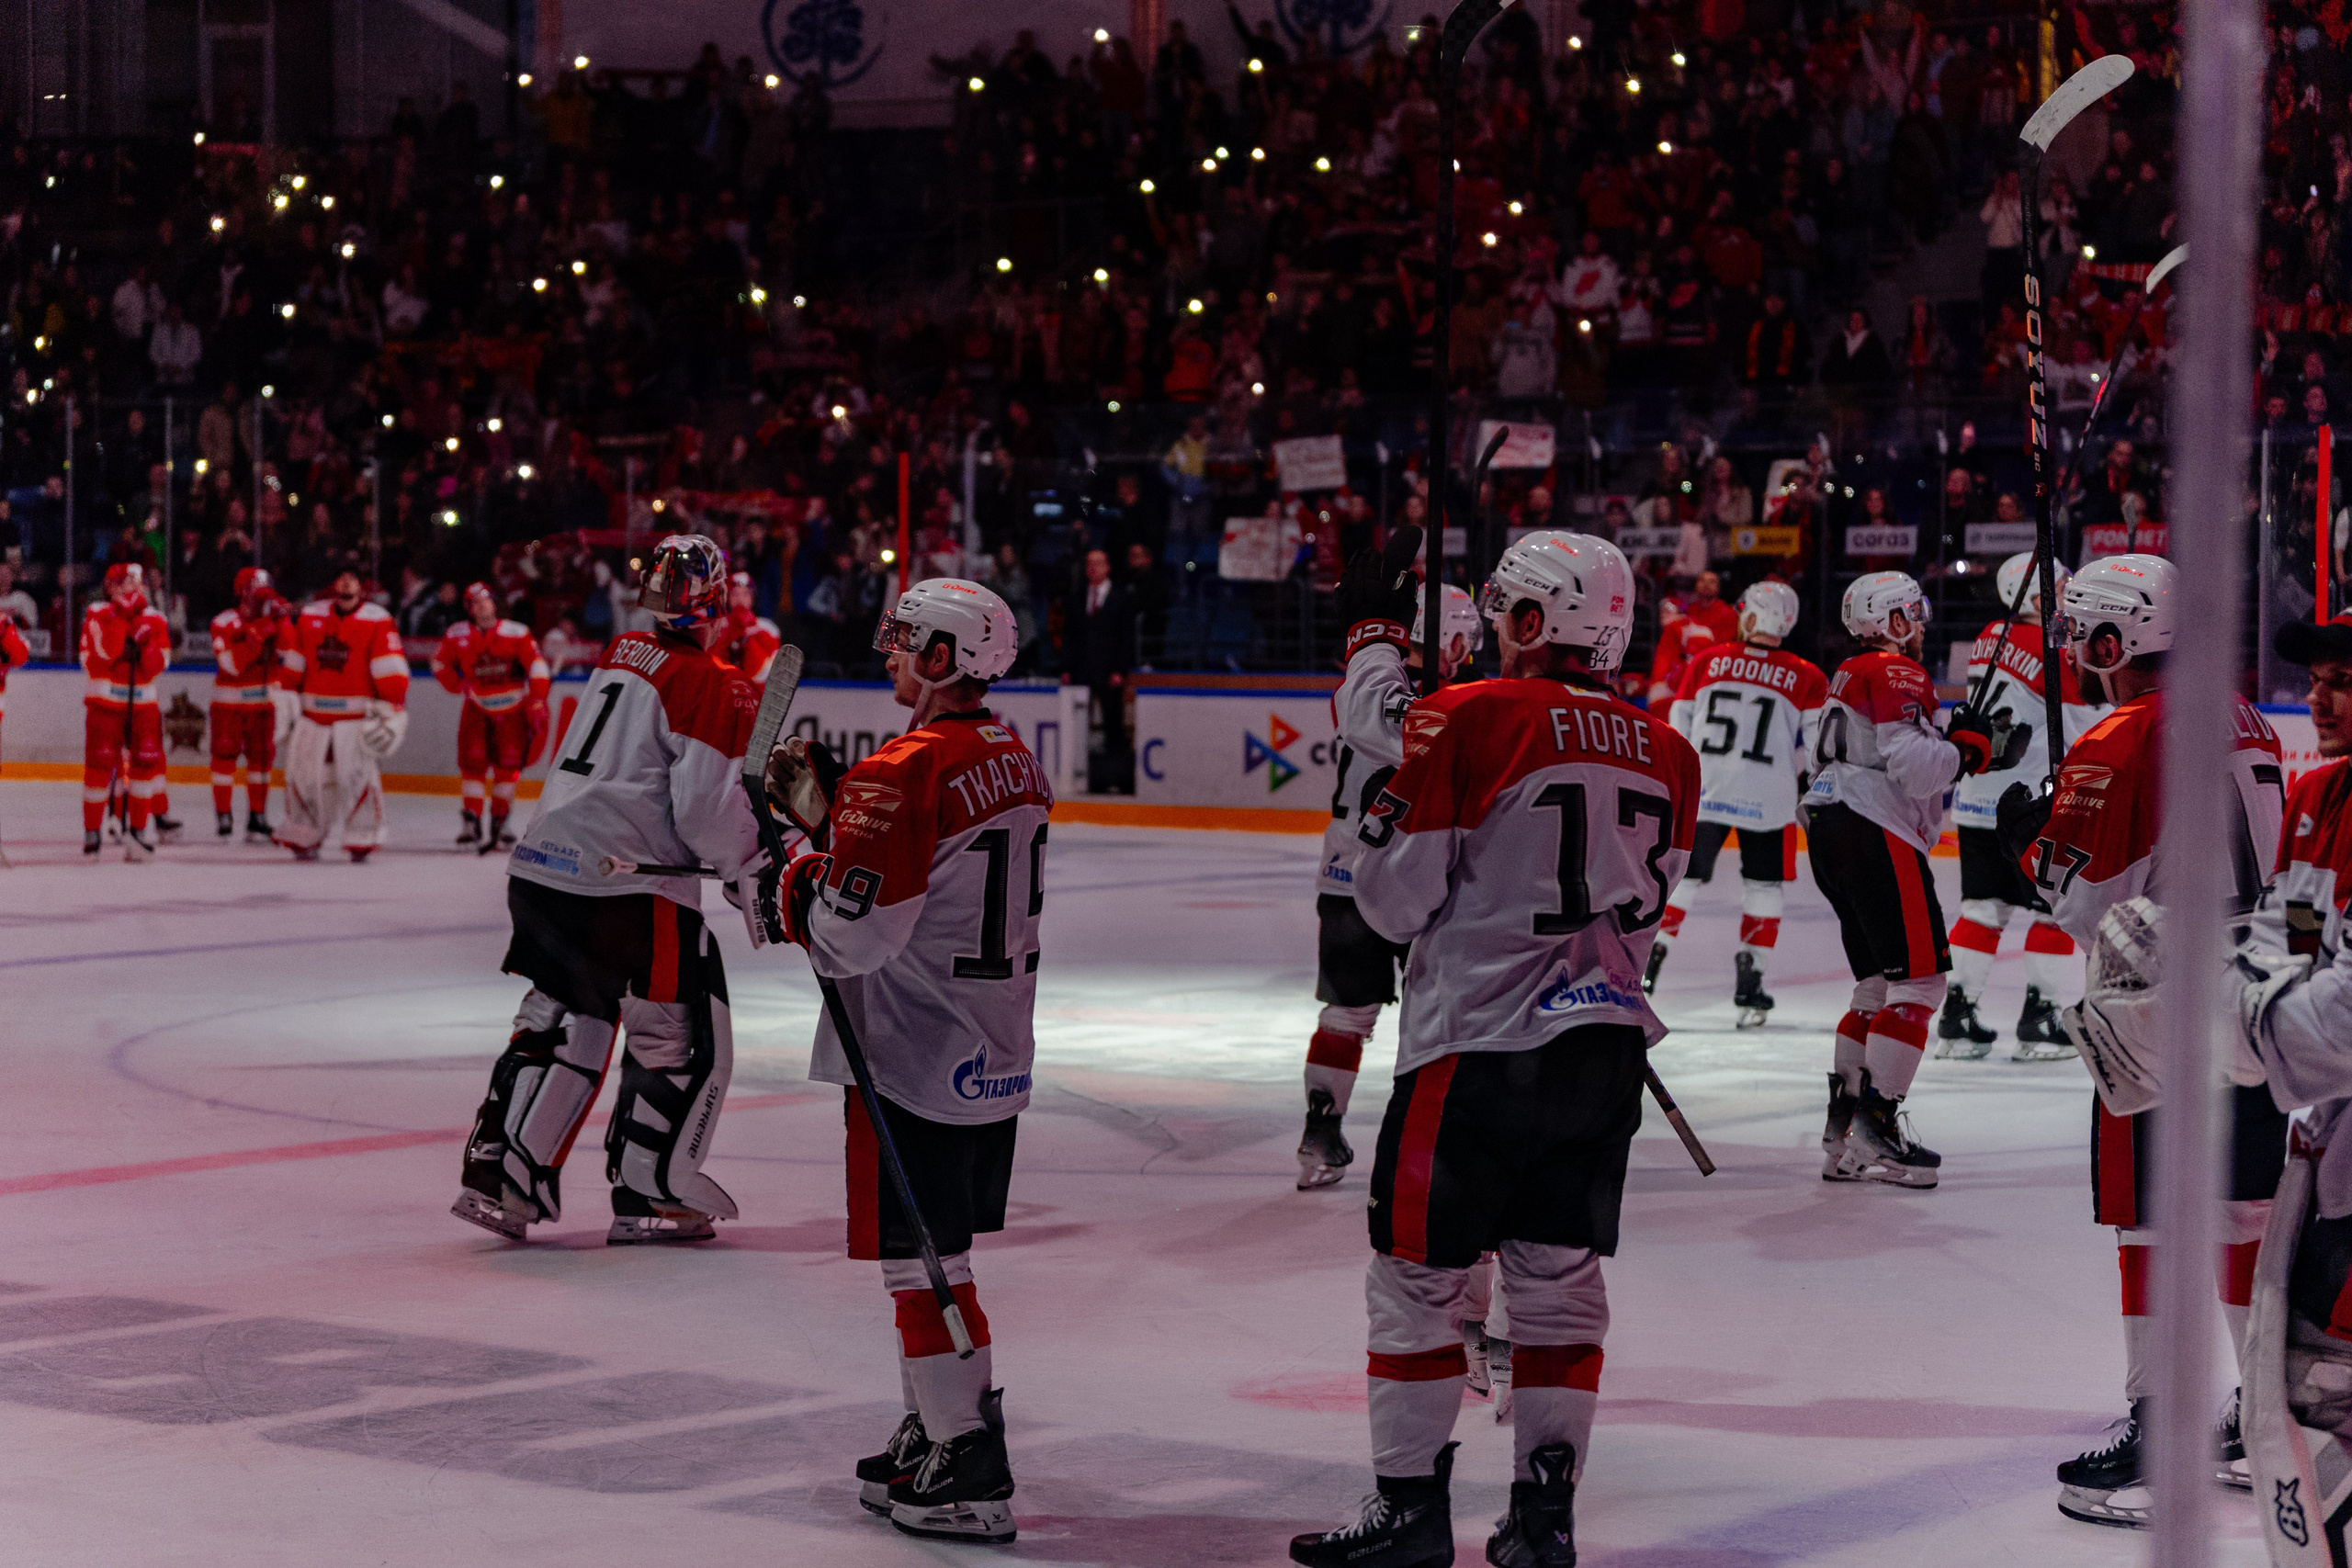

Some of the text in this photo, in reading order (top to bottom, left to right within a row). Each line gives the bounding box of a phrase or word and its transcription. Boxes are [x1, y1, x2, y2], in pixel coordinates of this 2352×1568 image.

[2024, 274, 2048, 450] SOYUZ
[1524, 578, 1550, 591] CCM
[2100, 604, 2129, 613] CCM
[610, 637, 671, 677] BERDIN
[1707, 655, 1798, 693] SPOONER
[559, 682, 625, 776] 1
[1548, 707, 1652, 765] FIORE
[1701, 690, 1776, 765] 51
[1359, 787, 1411, 849] 3
[818, 853, 885, 922] 19
[1531, 783, 1674, 936] 13
[2035, 836, 2093, 896] 17
[1346, 1539, 1393, 1562] BAUER
